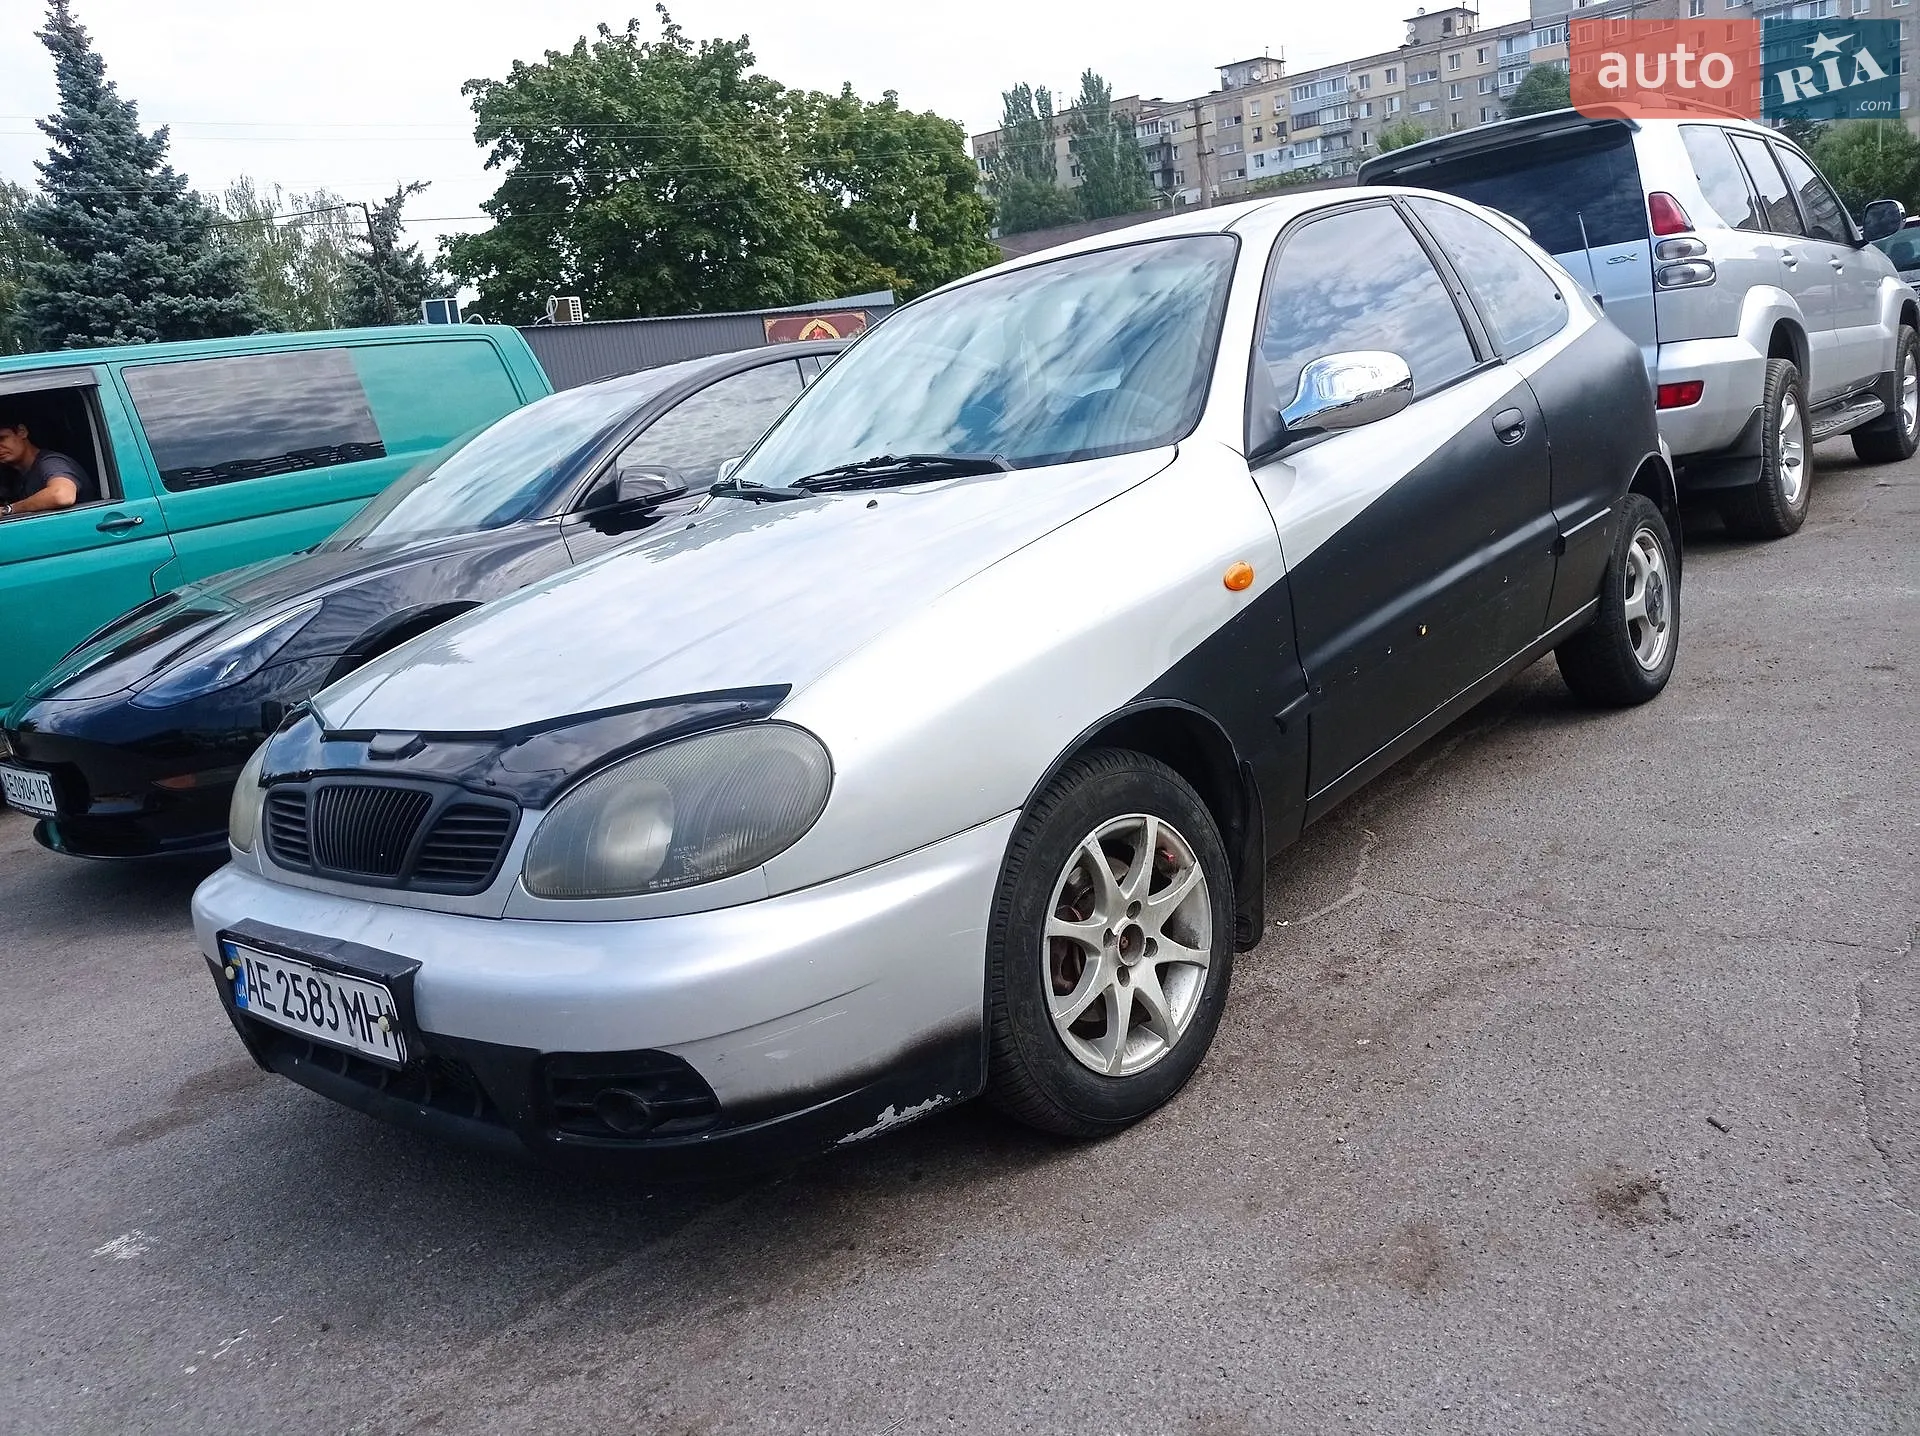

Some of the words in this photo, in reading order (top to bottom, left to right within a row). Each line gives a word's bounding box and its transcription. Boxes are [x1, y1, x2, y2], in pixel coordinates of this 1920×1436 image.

[236, 983, 247, 999] UA
[245, 957, 277, 1013] AE
[276, 969, 340, 1031] 2583
